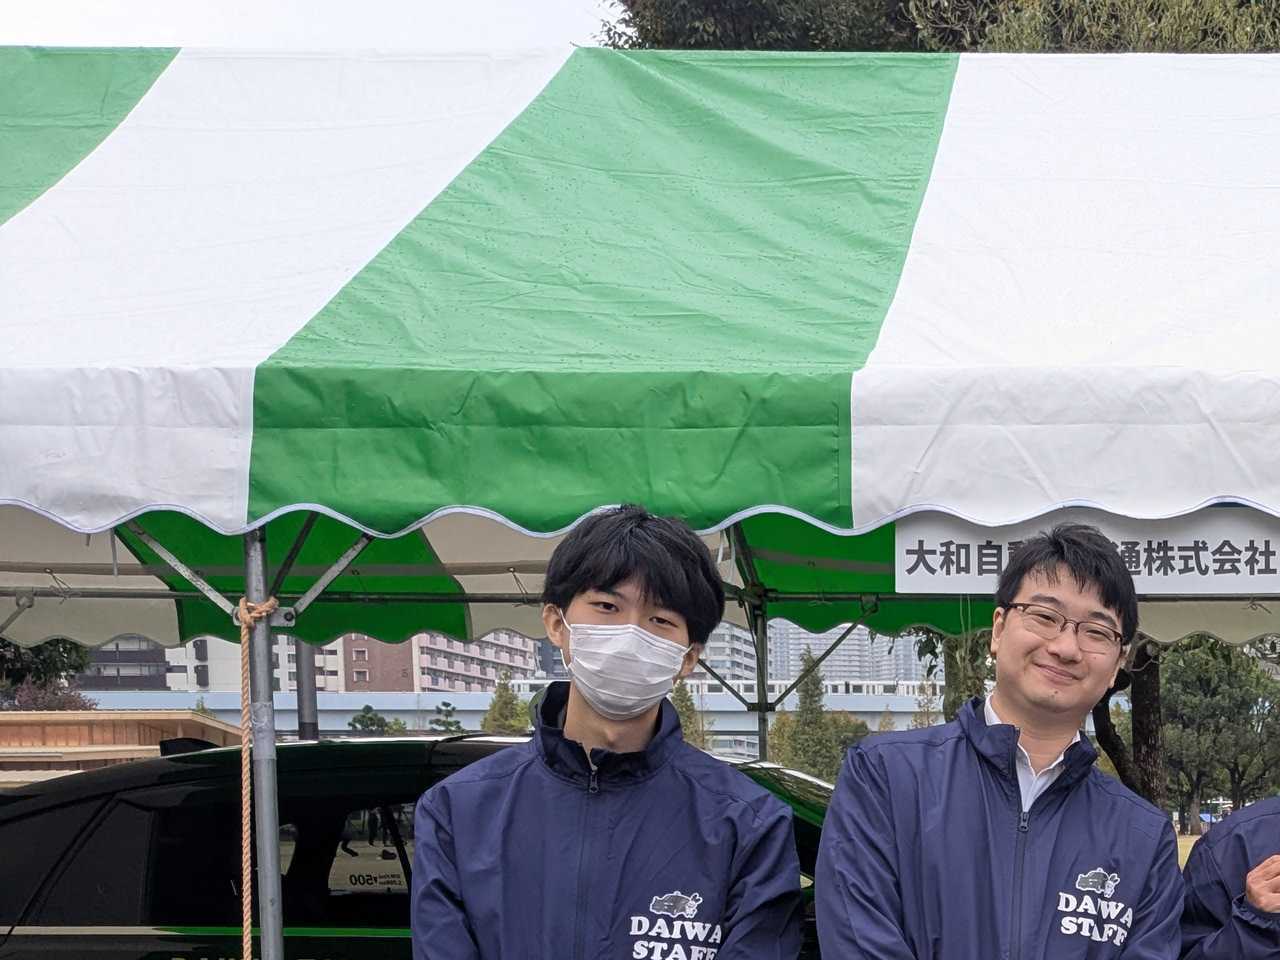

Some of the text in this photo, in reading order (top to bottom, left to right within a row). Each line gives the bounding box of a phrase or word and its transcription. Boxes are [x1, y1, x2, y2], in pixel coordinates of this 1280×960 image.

[905, 539, 1278, 577] 大和自通株式会社
[629, 916, 722, 943] DAIWA
